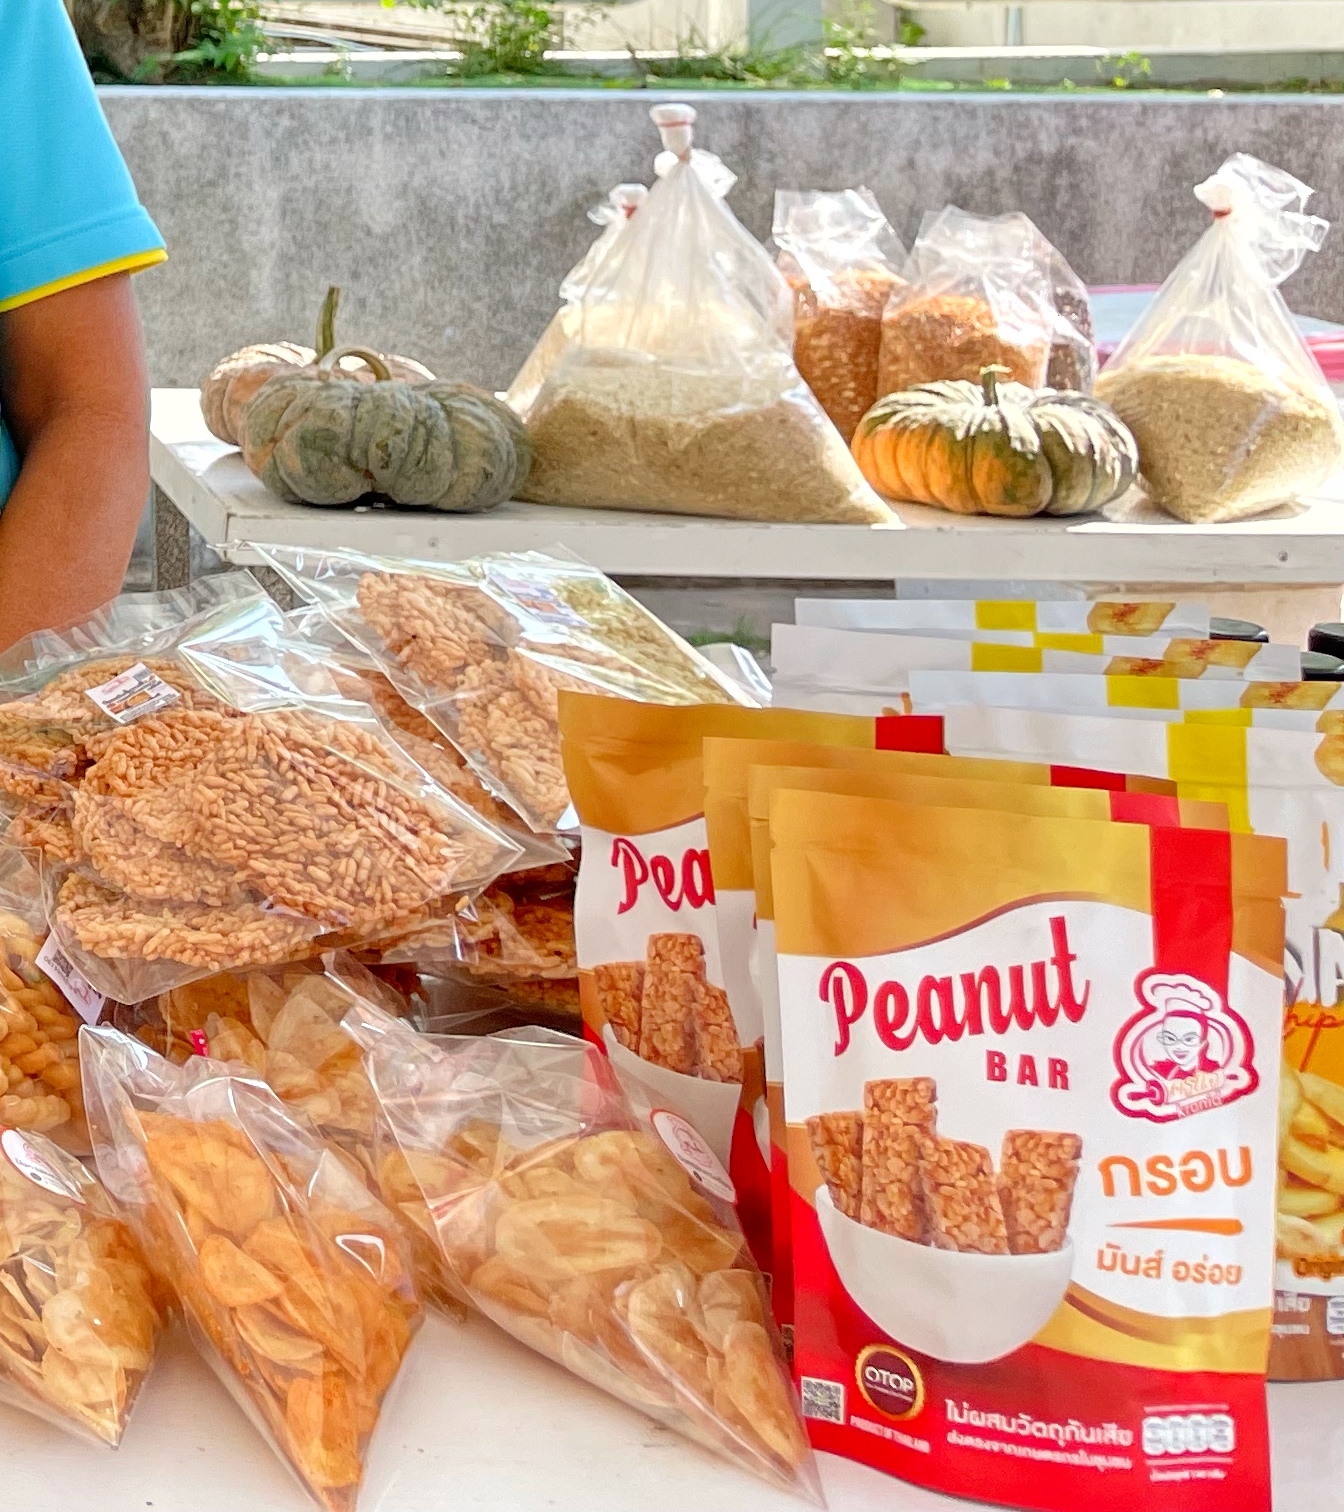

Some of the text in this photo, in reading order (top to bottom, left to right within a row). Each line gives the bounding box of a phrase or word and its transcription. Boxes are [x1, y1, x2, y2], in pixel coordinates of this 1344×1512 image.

[611, 838, 716, 915] Pea
[818, 915, 1091, 1057] Peanut
[985, 1049, 1070, 1090] BAR
[1098, 1146, 1253, 1197] กรอบ
[1097, 1242, 1243, 1285] มันส์ อร่อย
[865, 1366, 914, 1392] OTOP
[945, 1398, 1134, 1447] ไม่ผสมวัตถุกันเสีย
